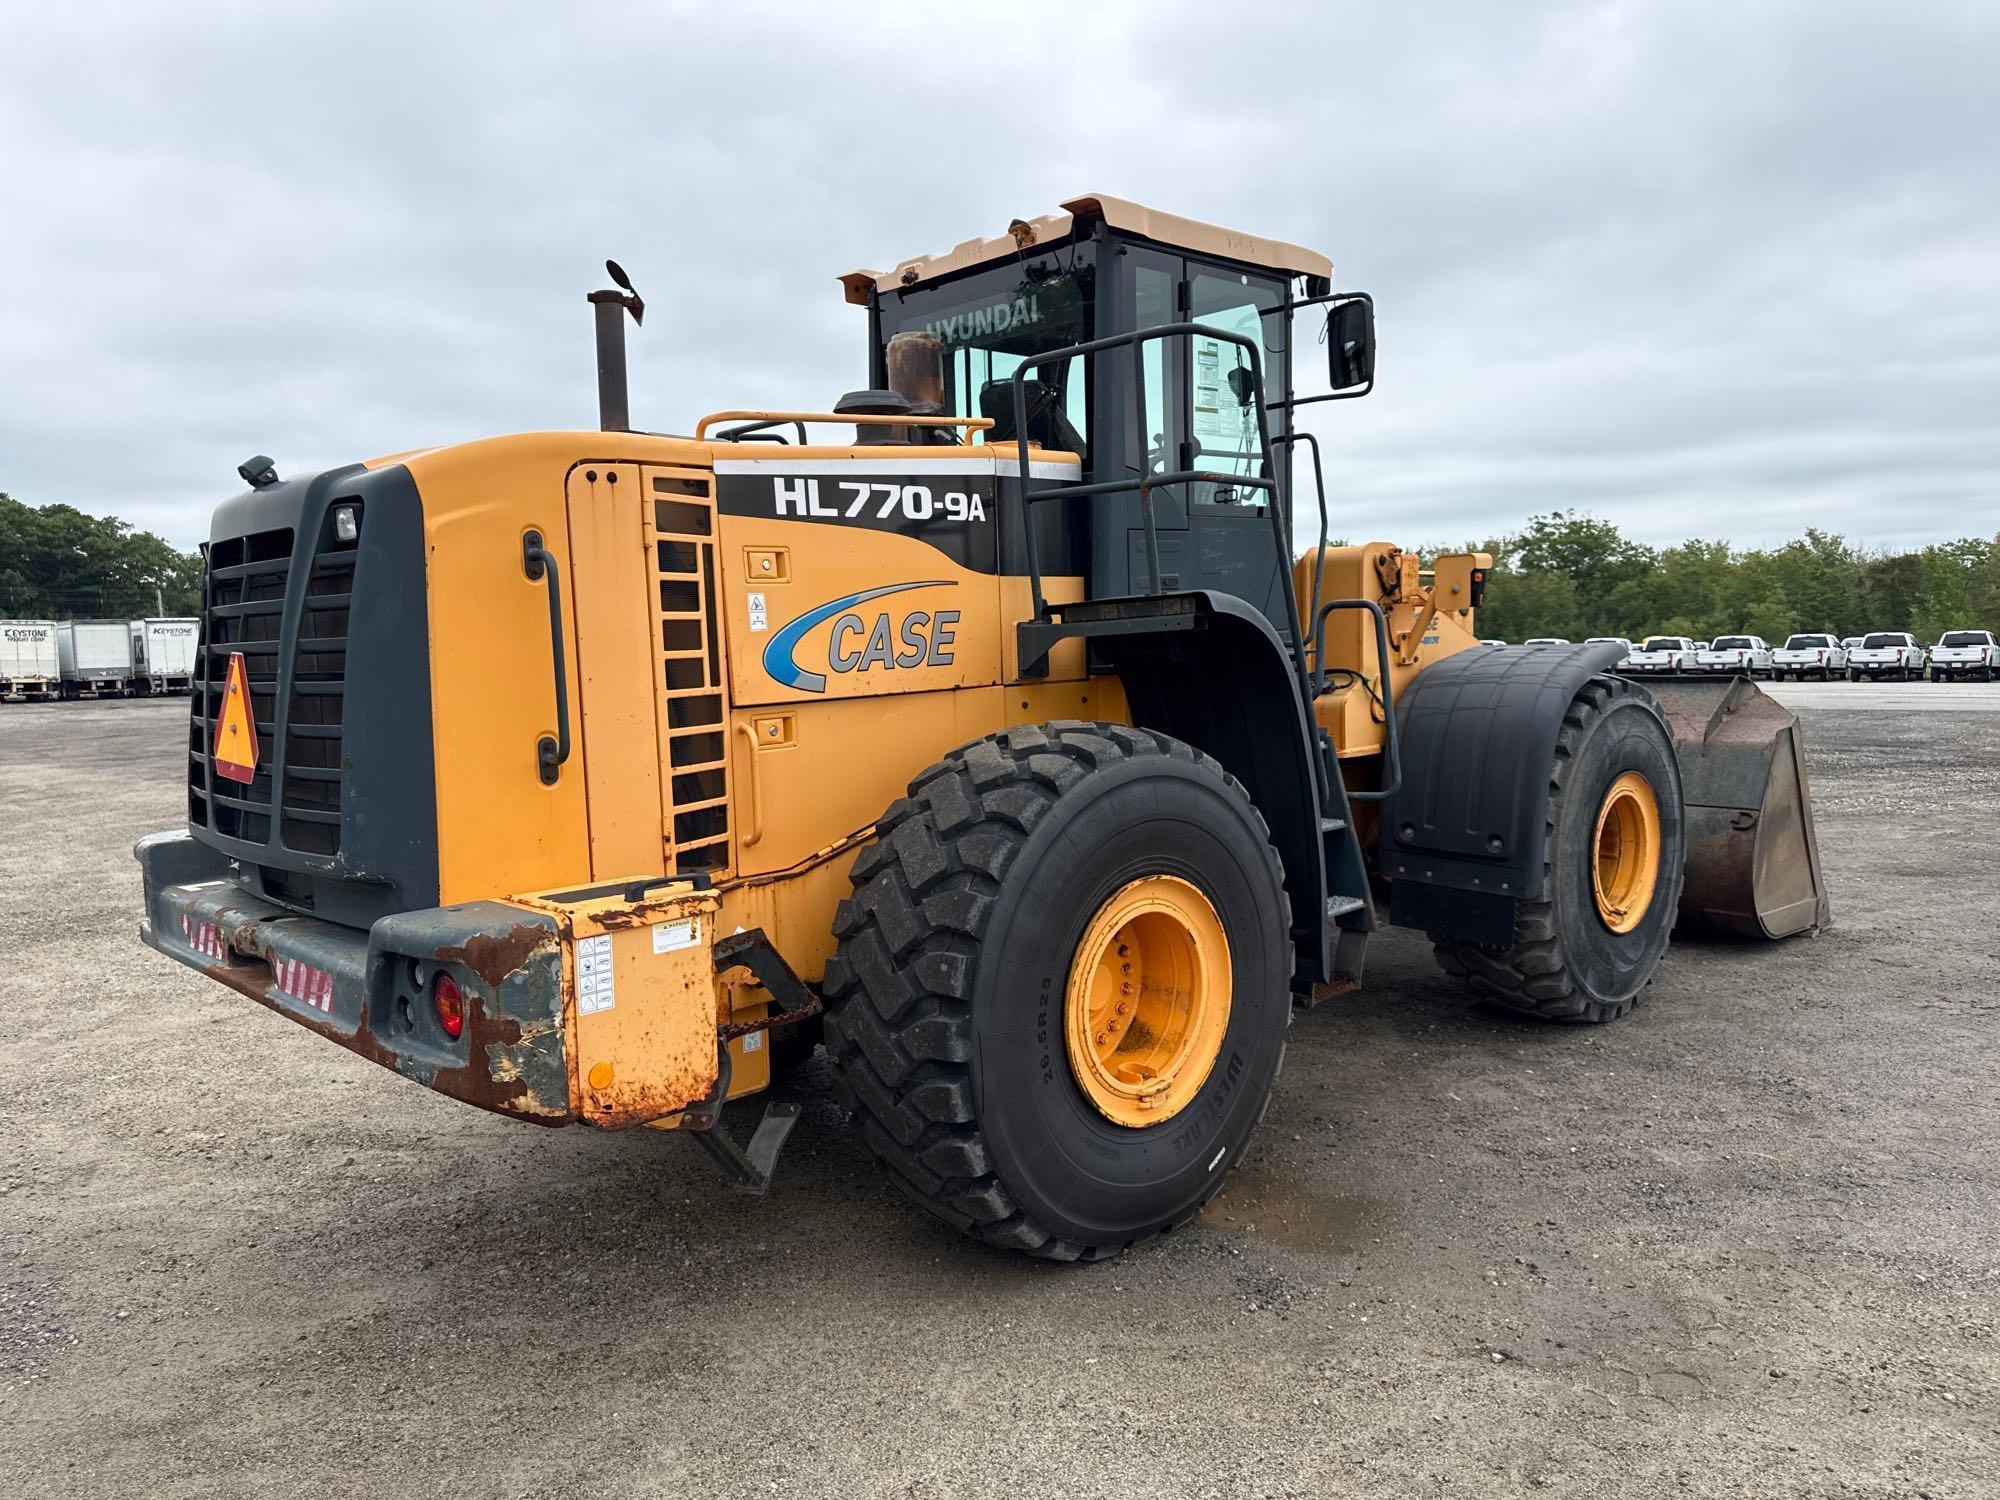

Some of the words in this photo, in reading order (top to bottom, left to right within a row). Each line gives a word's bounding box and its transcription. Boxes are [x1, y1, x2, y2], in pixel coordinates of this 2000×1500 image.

[926, 294, 1039, 345] HYUNDAI
[773, 476, 986, 522] HL770-9A
[4, 629, 48, 637] KEYSTONE
[153, 627, 193, 635] KEYSTONE
[828, 610, 961, 674] CASE
[1038, 976, 1053, 1085] 26.5R25
